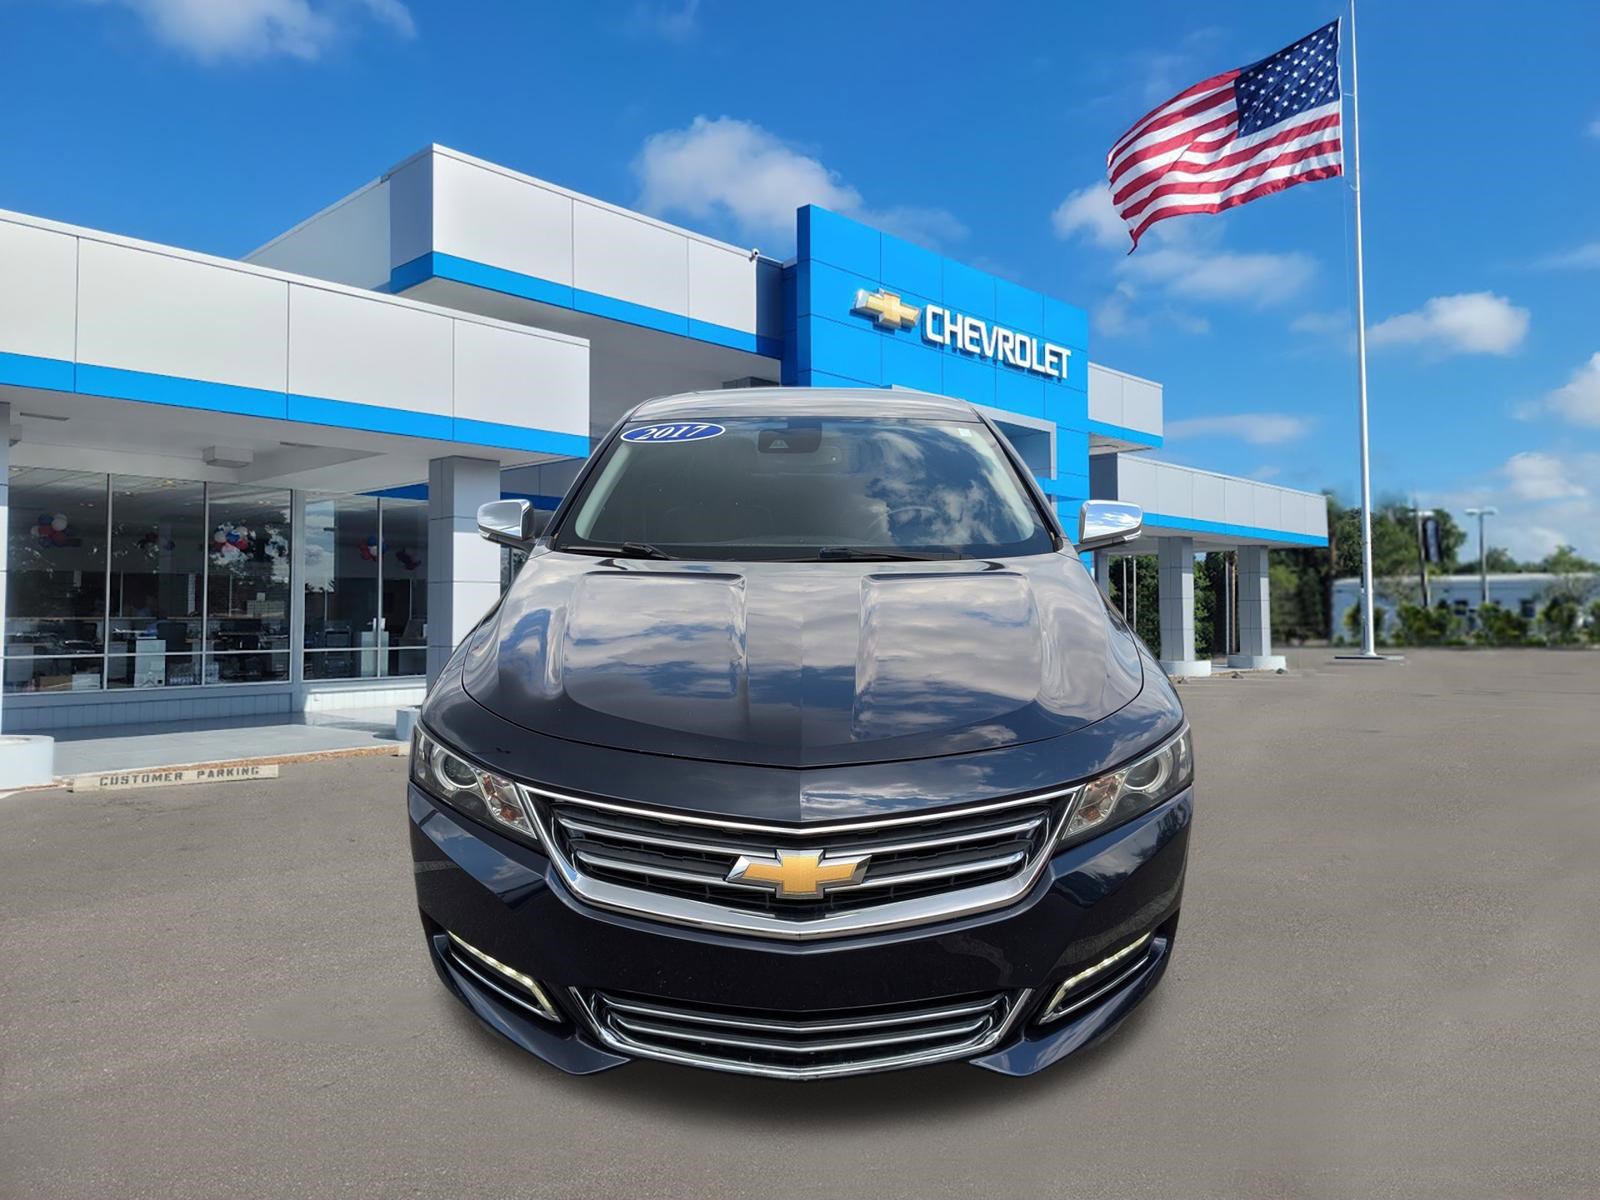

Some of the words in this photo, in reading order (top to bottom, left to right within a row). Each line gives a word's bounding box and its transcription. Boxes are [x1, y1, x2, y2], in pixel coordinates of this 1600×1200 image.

[925, 304, 1071, 378] CHEVROLET
[635, 425, 710, 440] 2017
[100, 772, 183, 786] CUSTOMER
[197, 766, 259, 779] PARKING
